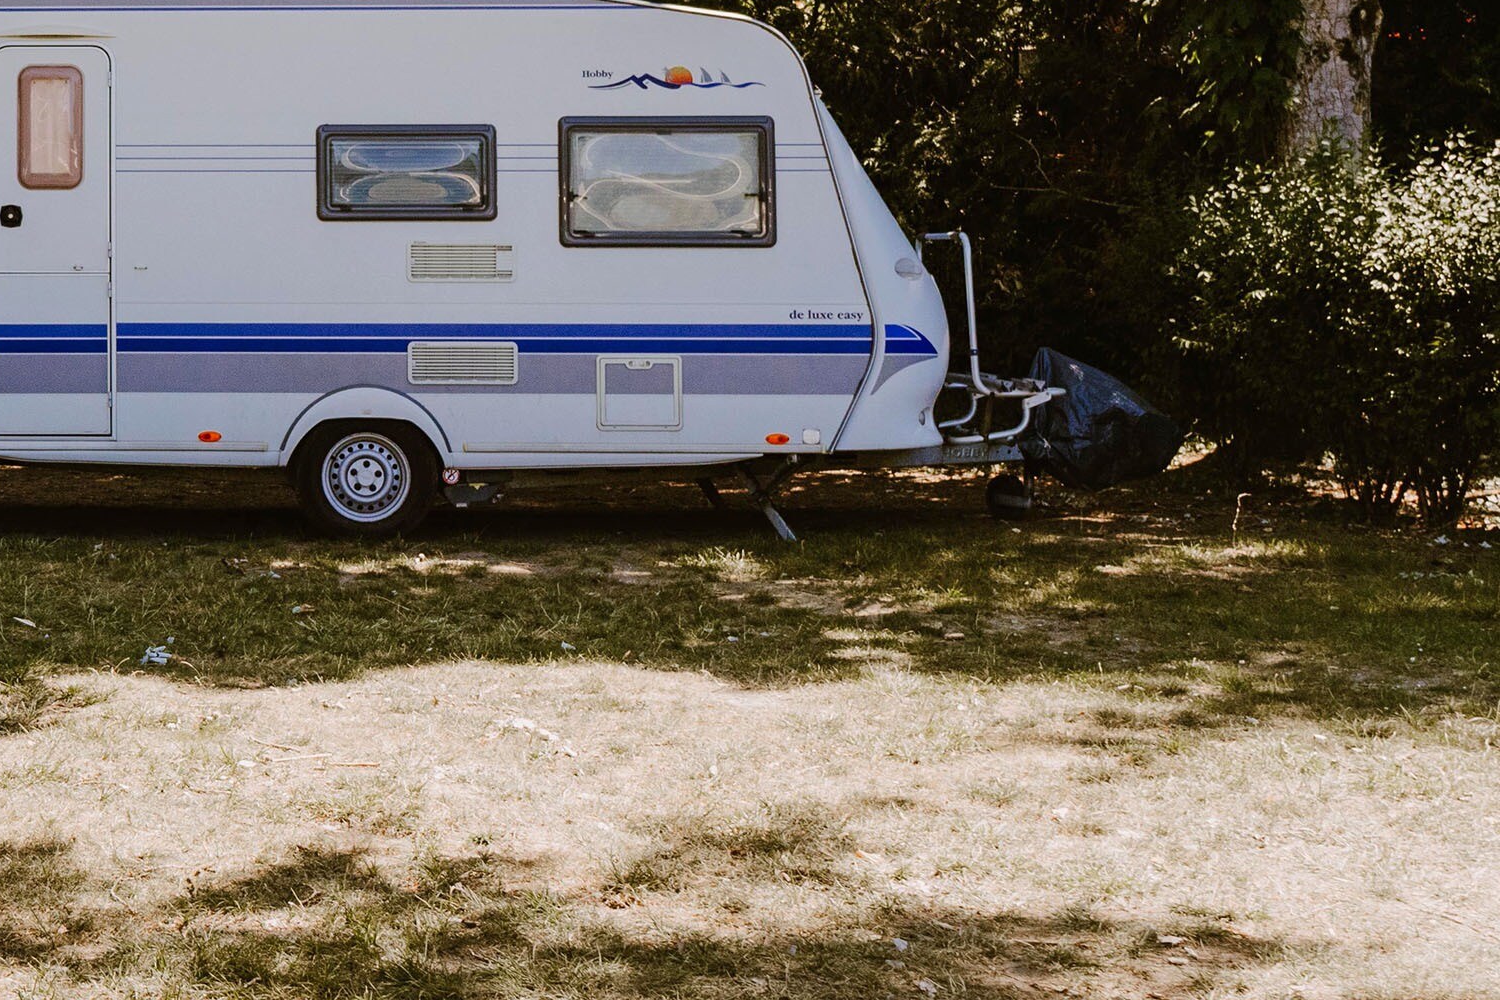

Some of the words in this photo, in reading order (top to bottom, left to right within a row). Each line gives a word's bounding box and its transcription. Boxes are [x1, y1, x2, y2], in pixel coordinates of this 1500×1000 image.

[582, 69, 614, 80] Hobby
[789, 309, 804, 320] de
[808, 309, 834, 320] luxe
[837, 311, 864, 322] easy
